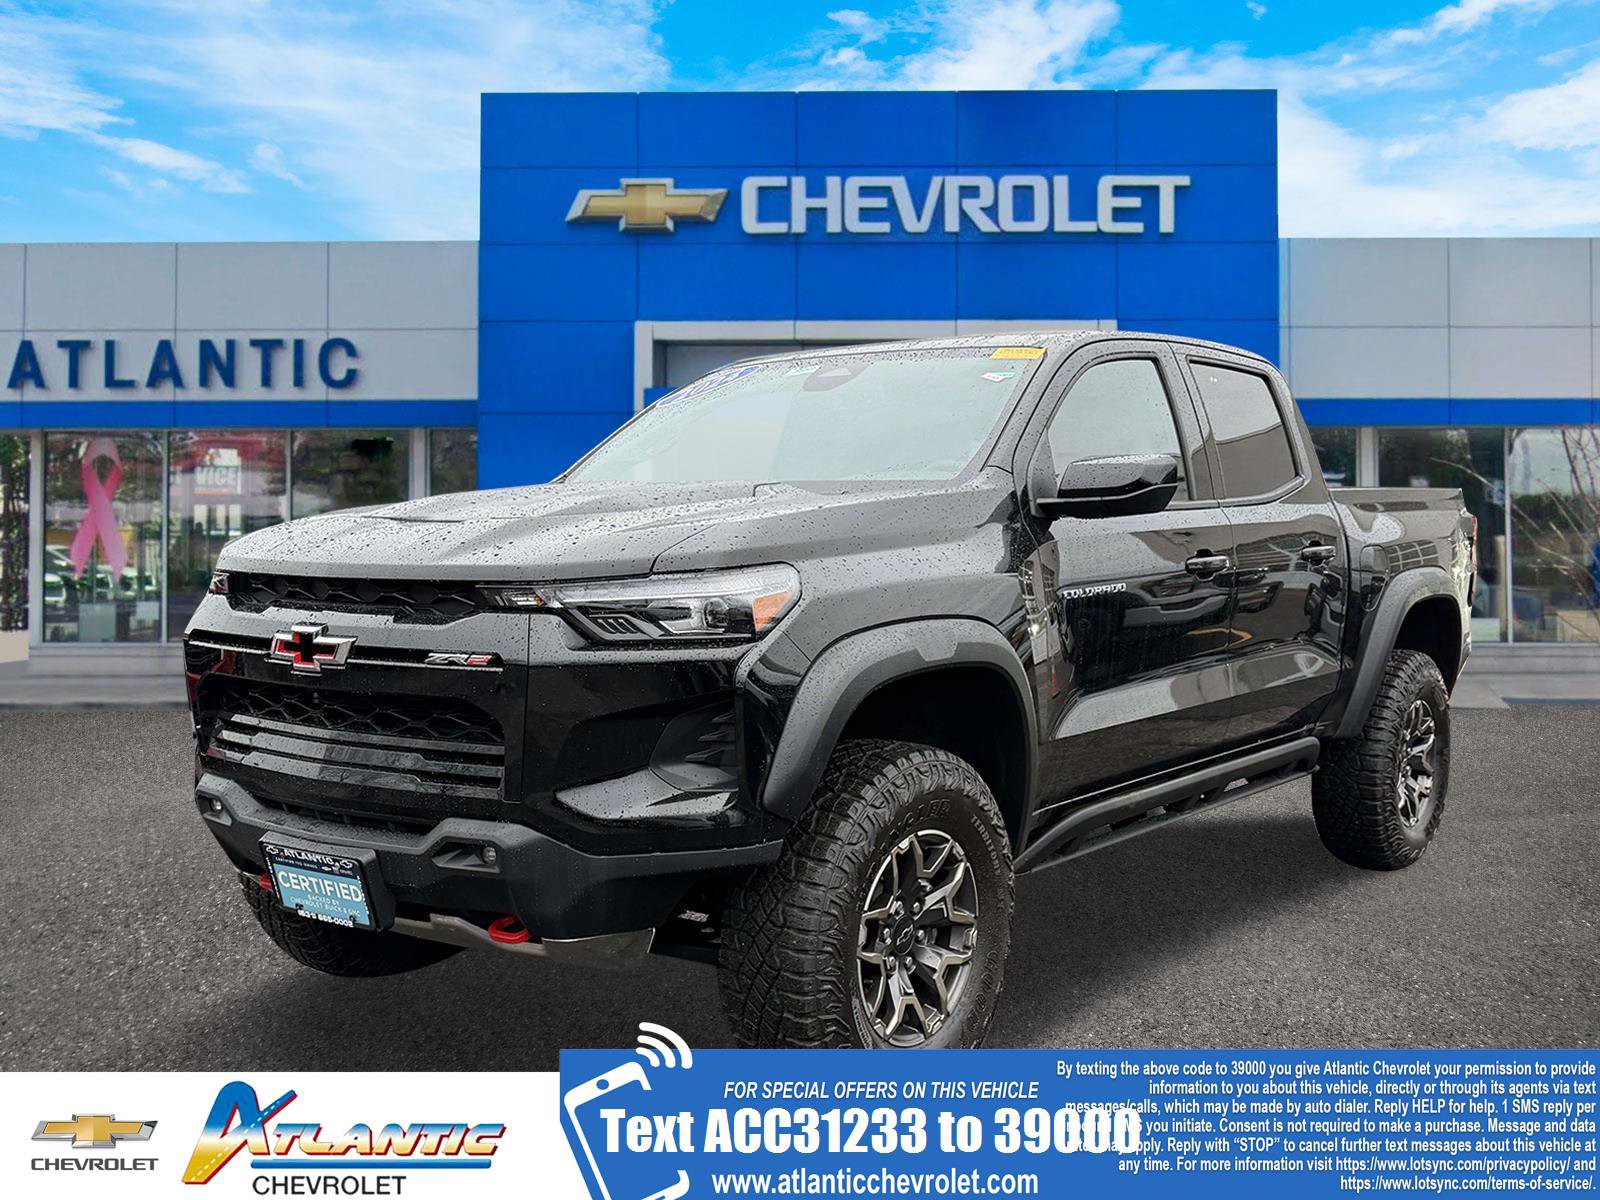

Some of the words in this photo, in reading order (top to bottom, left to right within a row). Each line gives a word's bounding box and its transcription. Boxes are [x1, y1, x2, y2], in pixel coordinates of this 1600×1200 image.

[741, 175, 1191, 234] CHEVROLET
[7, 337, 360, 390] ATLANTIC
[1062, 582, 1127, 599] COLORADO
[278, 870, 363, 902] CERTIFIED
